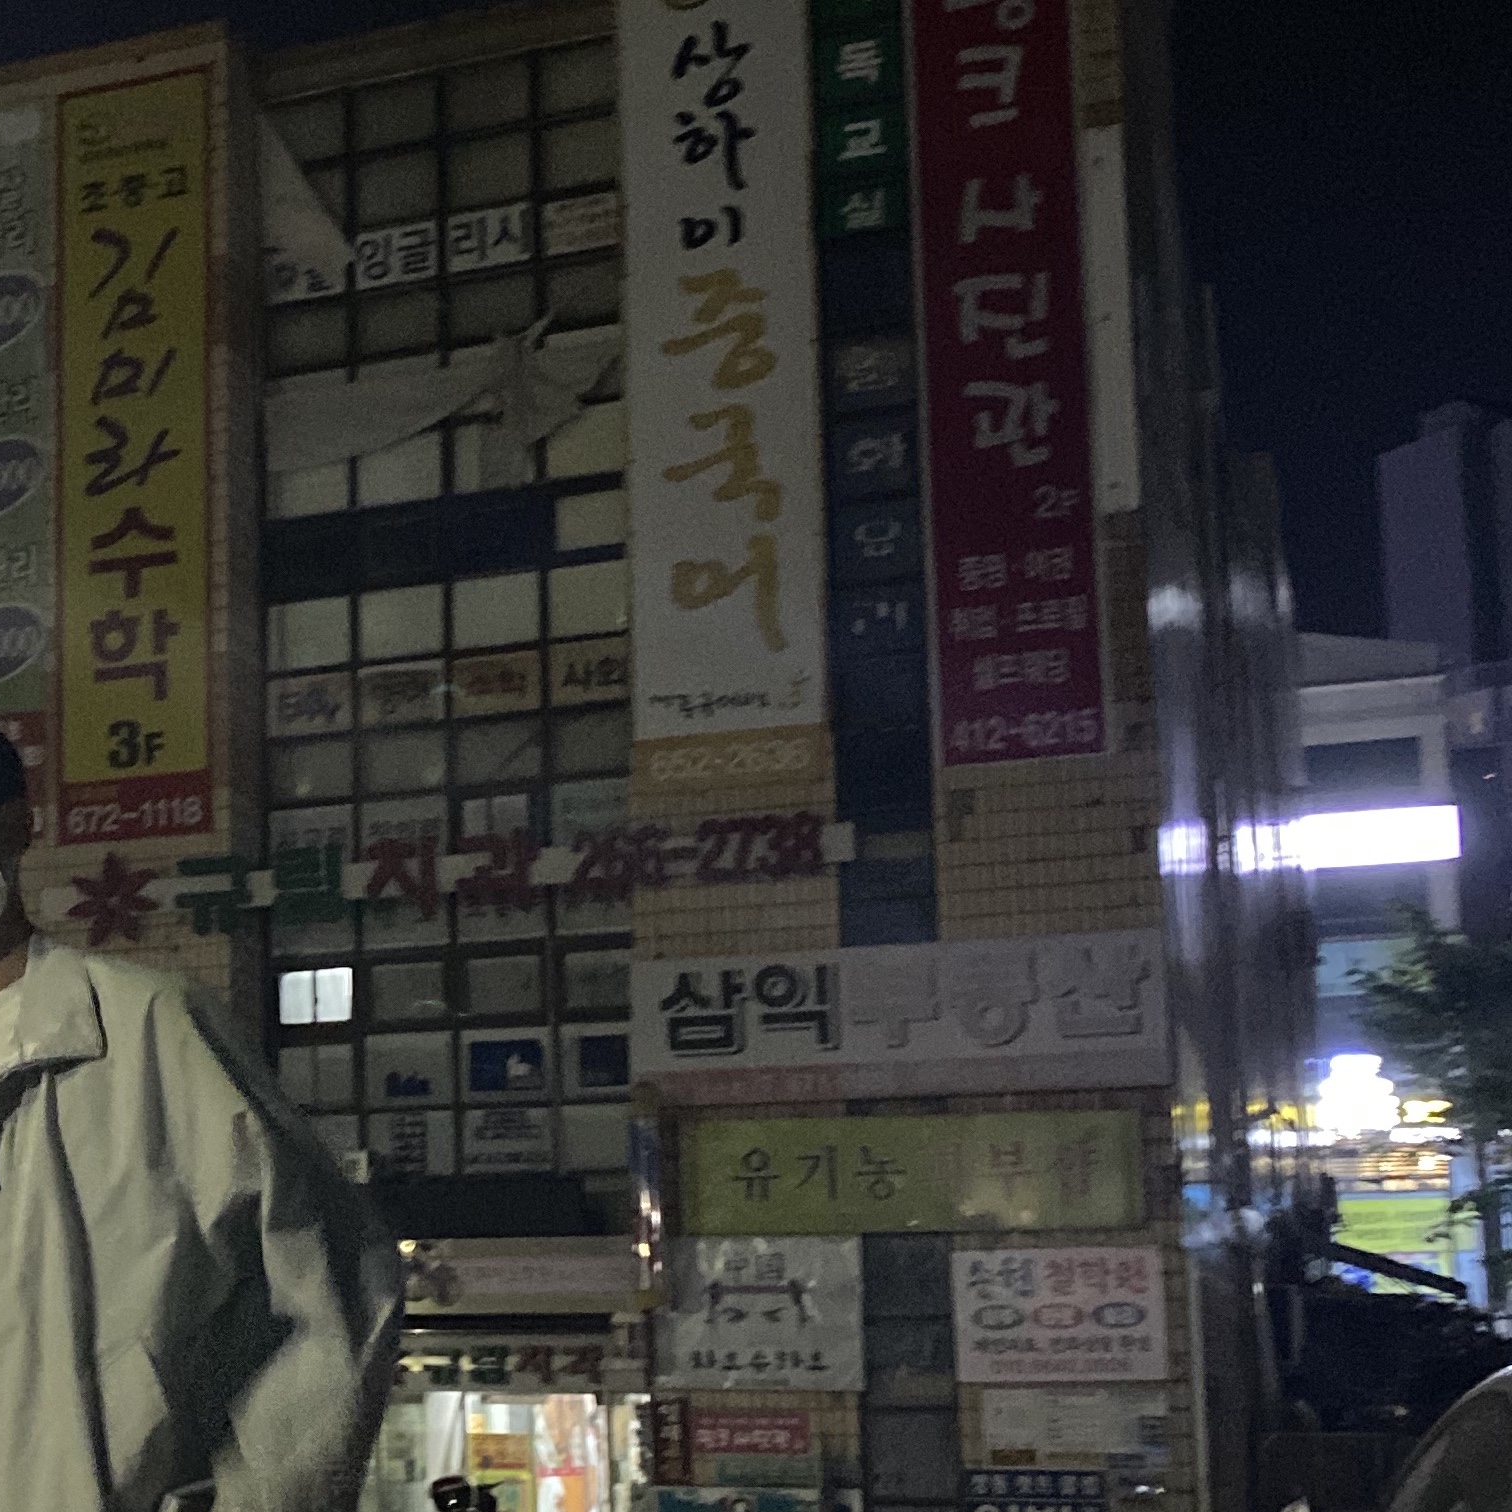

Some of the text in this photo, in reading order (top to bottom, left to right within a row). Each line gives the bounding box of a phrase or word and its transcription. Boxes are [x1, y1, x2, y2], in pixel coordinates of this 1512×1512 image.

[659, 268, 784, 653] 중국어
[107, 720, 165, 769] 3F
[66, 796, 204, 837] 672-1118
[732, 1144, 907, 1202] 유기농
